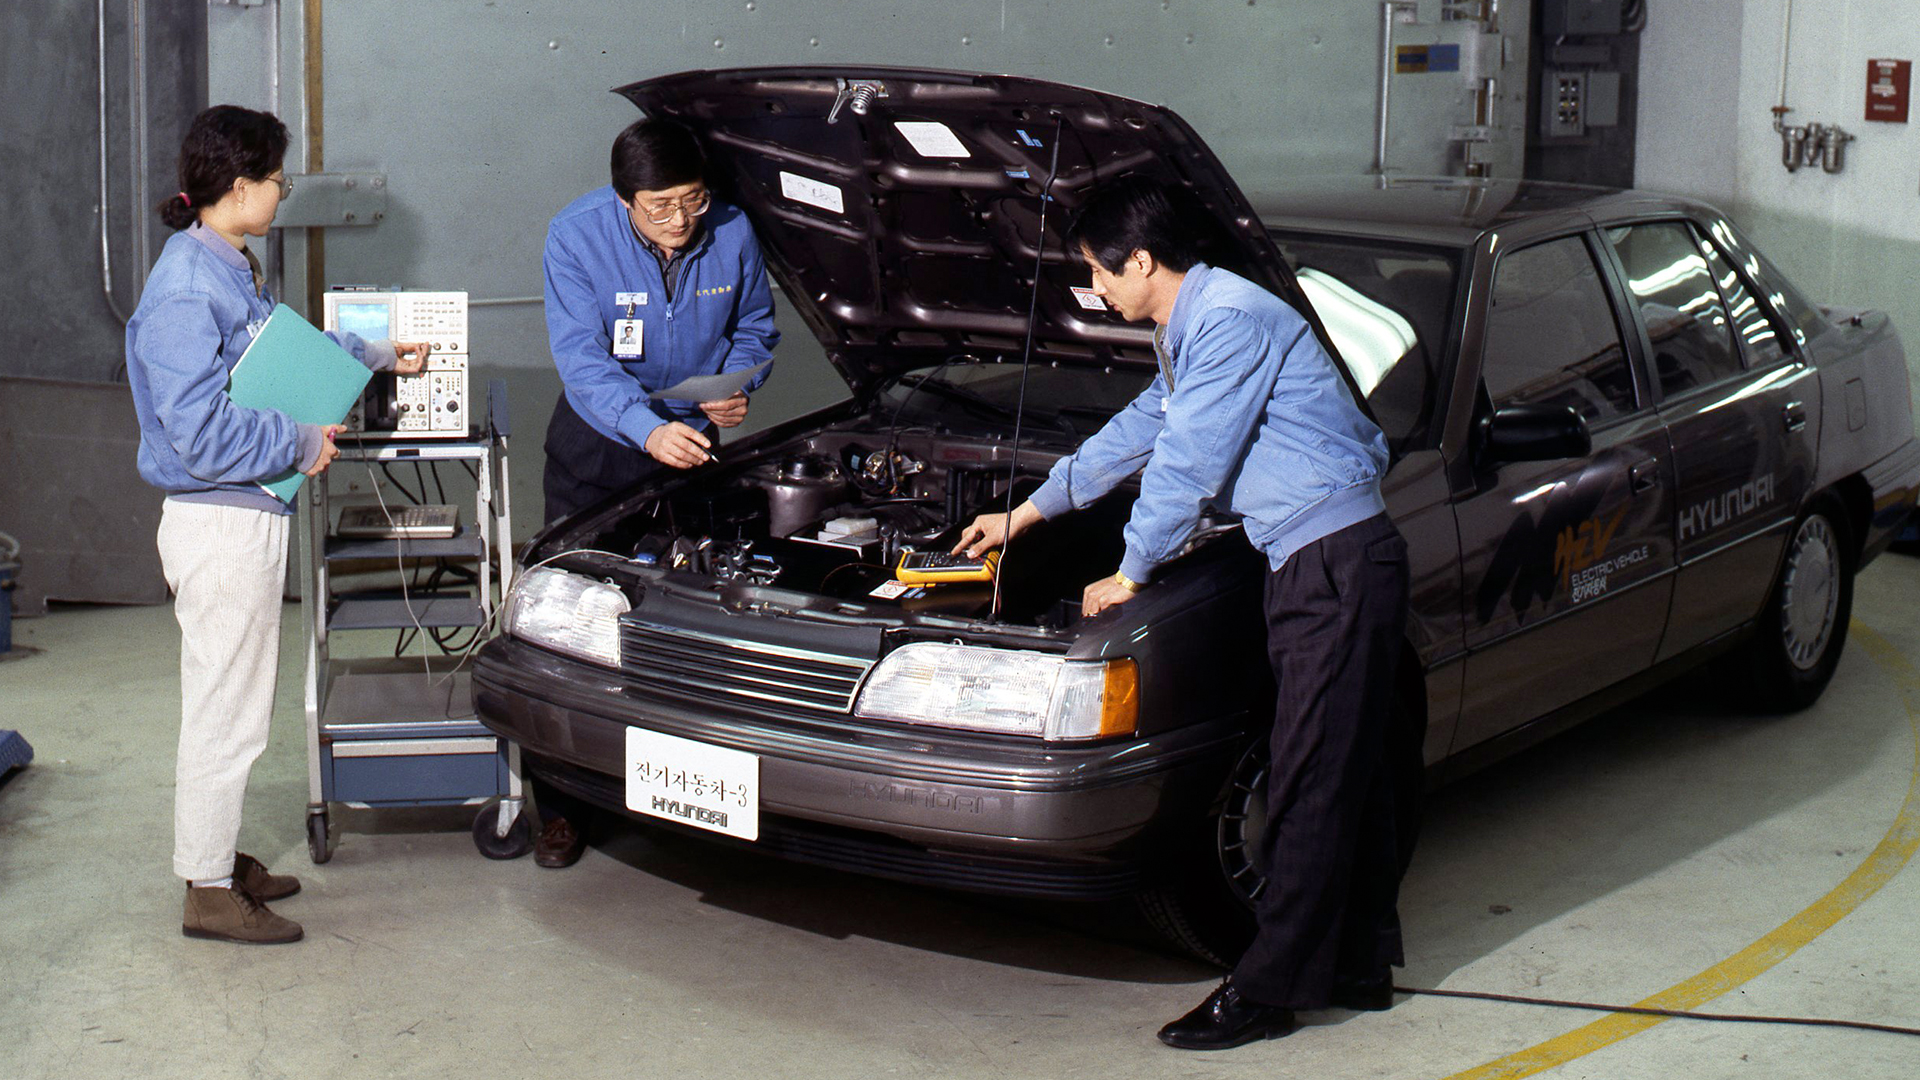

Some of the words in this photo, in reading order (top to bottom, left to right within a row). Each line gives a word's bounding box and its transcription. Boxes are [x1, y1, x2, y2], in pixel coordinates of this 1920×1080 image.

[1679, 472, 1775, 540] HYUNDAI
[1571, 560, 1613, 588] ELECTRIC
[1613, 545, 1649, 570] VEHICLE
[635, 761, 747, 808] 전기자동차-3
[851, 779, 984, 815] HYUNDAI
[651, 795, 728, 828] HYUNDAI
